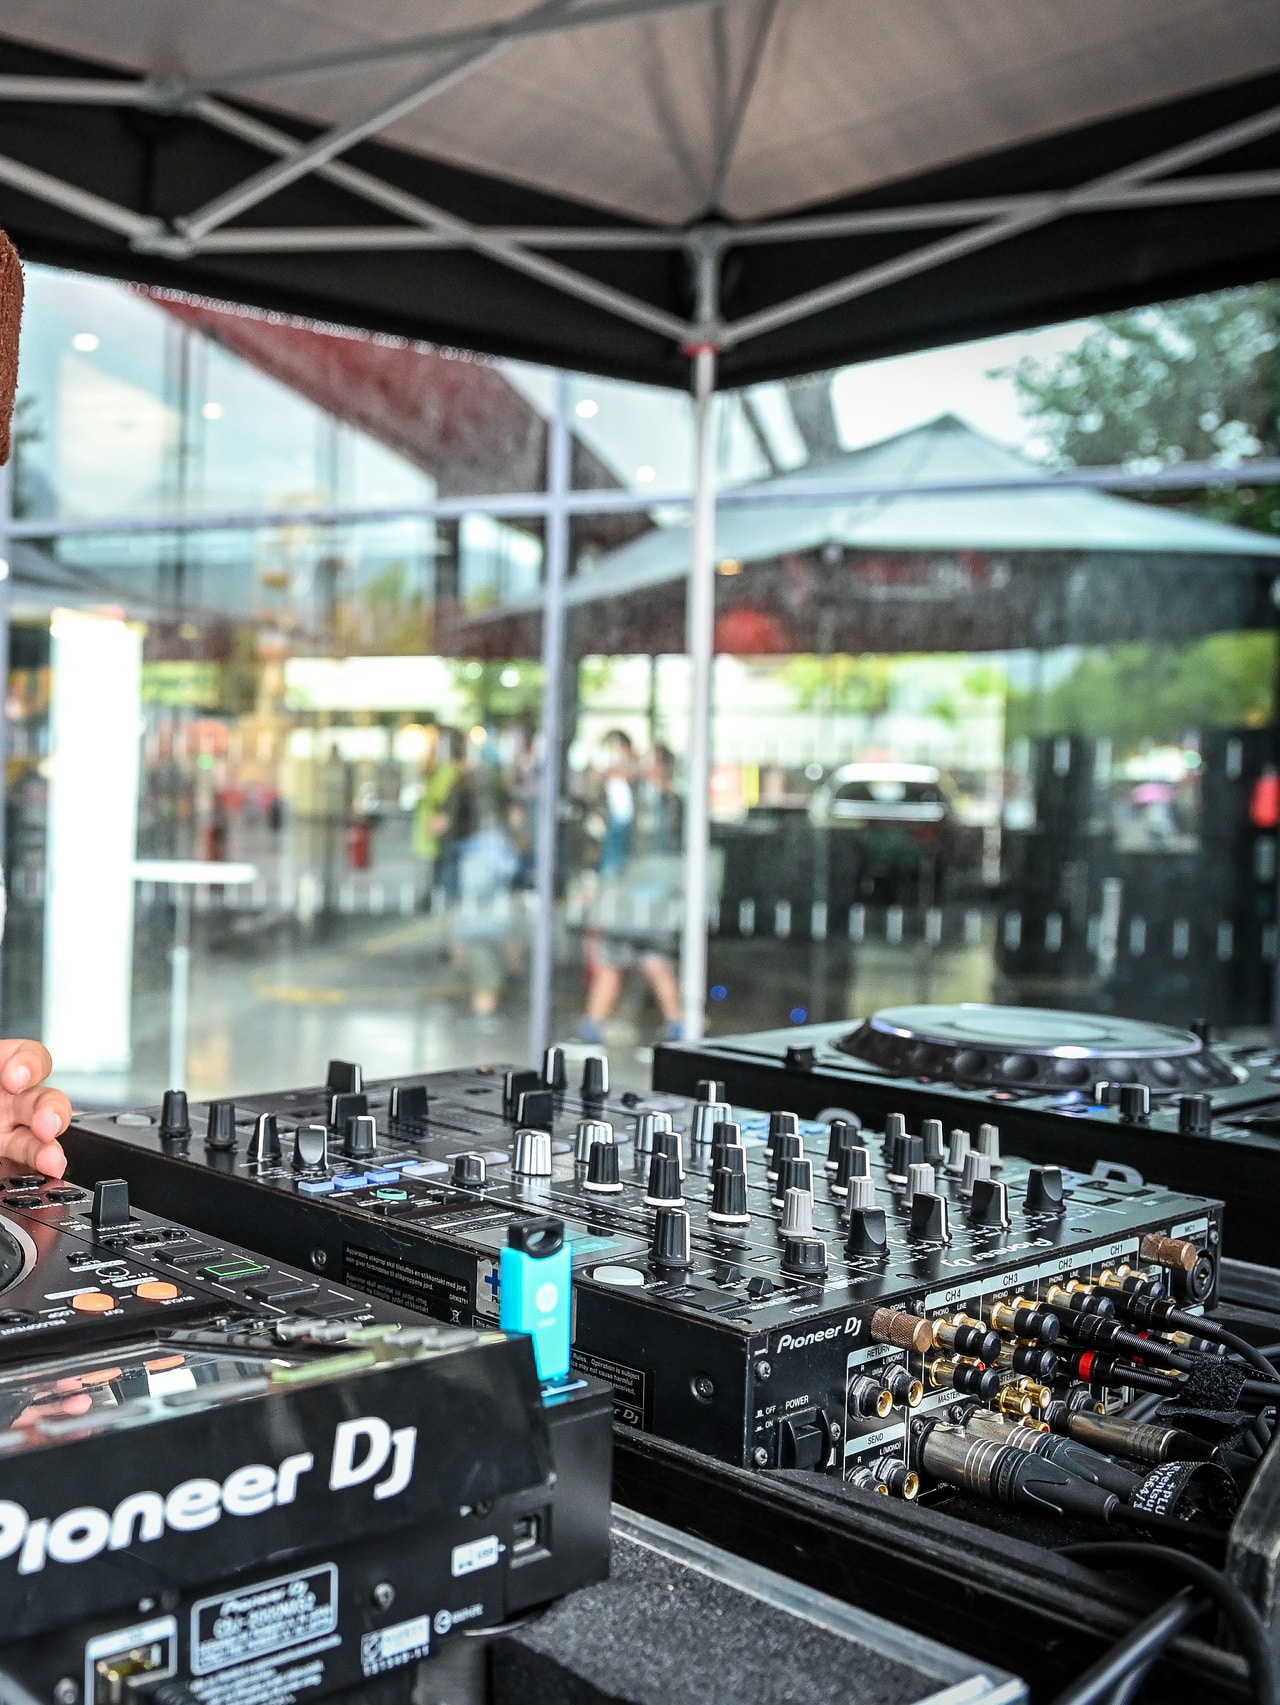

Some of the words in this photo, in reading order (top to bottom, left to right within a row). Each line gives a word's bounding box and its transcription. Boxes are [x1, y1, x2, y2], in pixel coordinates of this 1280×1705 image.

[972, 1237, 1054, 1262] Pioneer
[1110, 1244, 1124, 1256] CH1
[1058, 1258, 1073, 1270] CH2
[1101, 1260, 1116, 1269] PHONO
[1002, 1273, 1018, 1286] CH3
[1048, 1275, 1064, 1285] PHONO
[945, 1290, 962, 1303] CH4
[992, 1291, 1009, 1301] PHONO
[1015, 1286, 1025, 1295] LINE
[932, 1308, 950, 1318] PHONO
[956, 1302, 968, 1311] LINE
[777, 1324, 842, 1354] Pioneer
[866, 1345, 890, 1359] RETURN
[578, 1363, 589, 1372] may
[589, 1366, 598, 1374] not
[598, 1370, 613, 1380] cause
[613, 1374, 634, 1386] harmful
[591, 1358, 615, 1372] Operation
[621, 1368, 640, 1380] subject
[785, 1394, 809, 1411] POWER
[765, 1405, 777, 1415] OFF
[765, 1420, 774, 1429] ON
[867, 1432, 884, 1445] SEND
